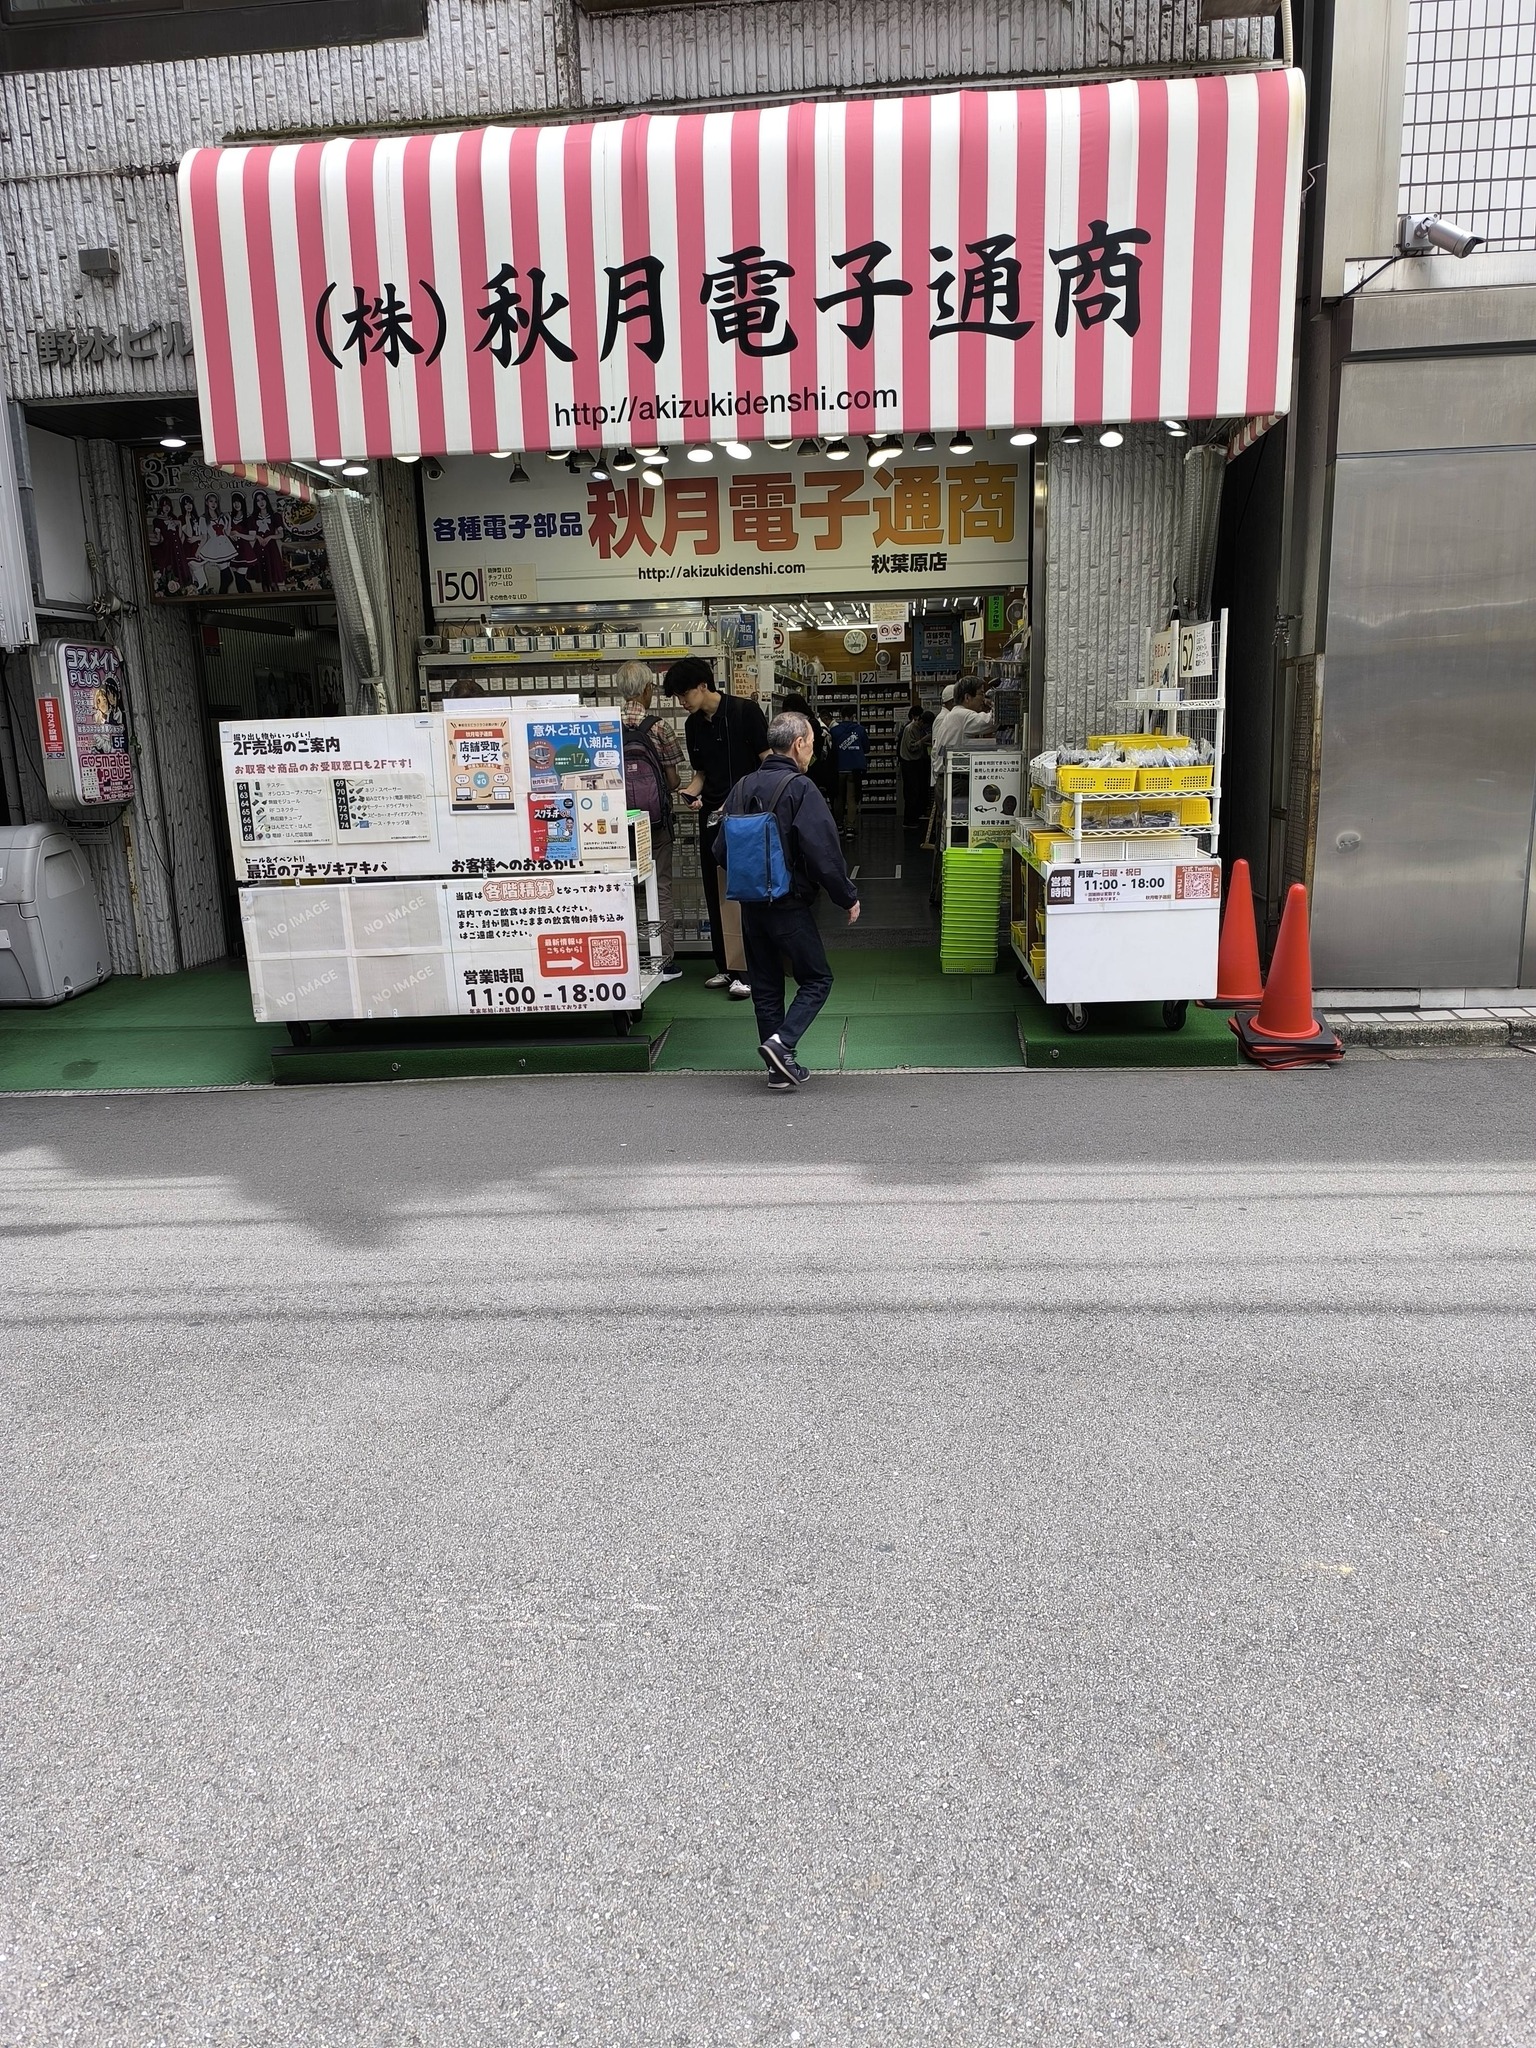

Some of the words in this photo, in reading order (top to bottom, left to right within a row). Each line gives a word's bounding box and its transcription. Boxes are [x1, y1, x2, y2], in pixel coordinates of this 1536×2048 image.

[36, 320, 194, 365] 野水ビル
[554, 386, 898, 428] http://akizukidenshi.com
[145, 459, 182, 489] 3F
[586, 461, 1018, 559] 秋月電子通商
[433, 512, 583, 542] 各種電子部品
[638, 562, 806, 582] http://akizukidenshi.com
[872, 552, 947, 574] 秋葉原店
[445, 571, 478, 601] 50
[970, 622, 977, 639] 7
[901, 654, 909, 666] 21
[1183, 633, 1194, 671] 52
[70, 671, 100, 687] PLUS
[820, 673, 833, 684] 23
[862, 672, 875, 683] 22
[533, 723, 598, 737] 意外と近い、
[114, 737, 125, 748] 5F
[233, 737, 341, 756] 2F売場のご案内
[460, 741, 500, 752] 店舗受取
[578, 736, 617, 749] 八潮店。
[235, 759, 412, 775] お取寄せ商品のお受取窓口も2Fです!
[462, 753, 499, 763] サービス
[247, 861, 388, 879] 最近のアキヅキアキバ
[456, 891, 483, 901] 当店は
[484, 880, 554, 901] 各階精算
[556, 883, 626, 895] となっております。
[1051, 876, 1072, 887] 営業
[1084, 879, 1118, 891] 11:00
[1130, 877, 1165, 889] 18:00
[1050, 887, 1072, 898] 時間
[267, 922, 288, 940] NO
[288, 900, 331, 928] IMAGE
[363, 918, 384, 936] NO
[384, 896, 427, 924] IMAGE
[457, 904, 593, 918] 店内でのご飲食はお控えください。
[459, 930, 533, 940] はご遠慮ください。
[544, 938, 583, 946] 最新情報は
[371, 988, 392, 1005] NO
[392, 965, 435, 994] IMAGE
[463, 967, 524, 985] 営業時間
[275, 991, 296, 1008] NO
[297, 969, 339, 998] IMAGE
[466, 986, 536, 1007] 11:00
[557, 982, 627, 1003] 18:00
